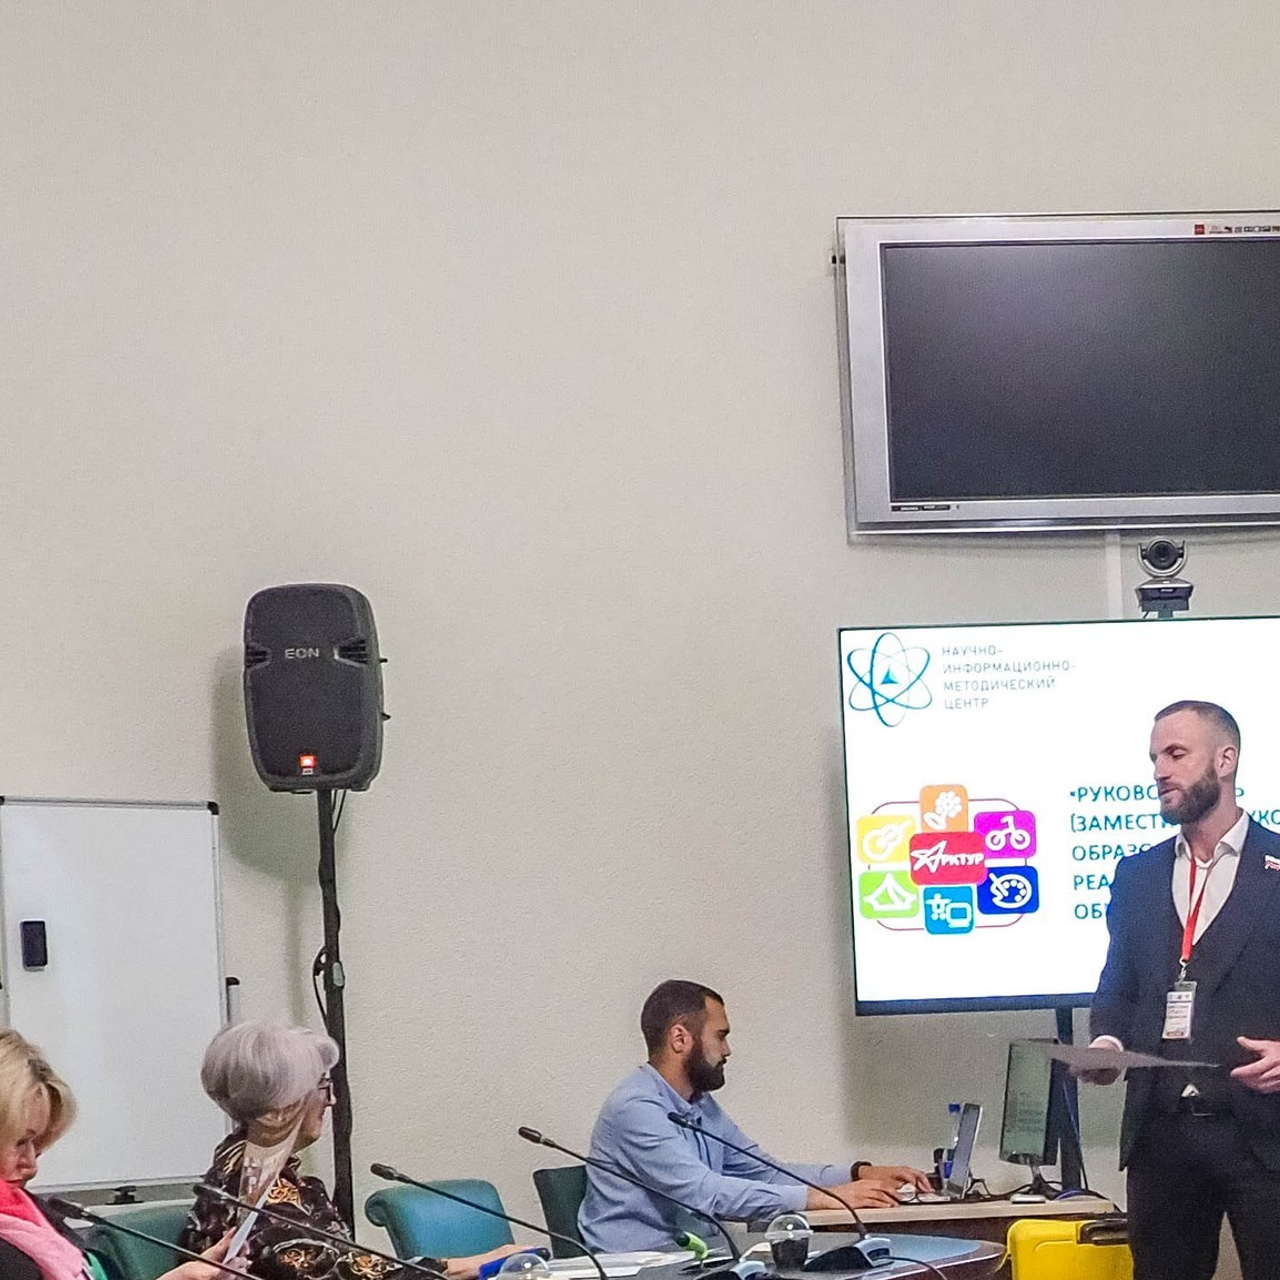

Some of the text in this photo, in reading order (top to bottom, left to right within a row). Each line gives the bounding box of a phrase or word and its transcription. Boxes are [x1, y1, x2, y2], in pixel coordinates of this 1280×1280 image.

[284, 647, 320, 660] EON
[942, 644, 1004, 656] НАУЧНО-
[943, 660, 1076, 674] ИНФОРМАЦИОННО-
[943, 675, 1056, 692] МЕТОДИЧЕСКИЙ
[944, 697, 989, 710] ЦЕНТР
